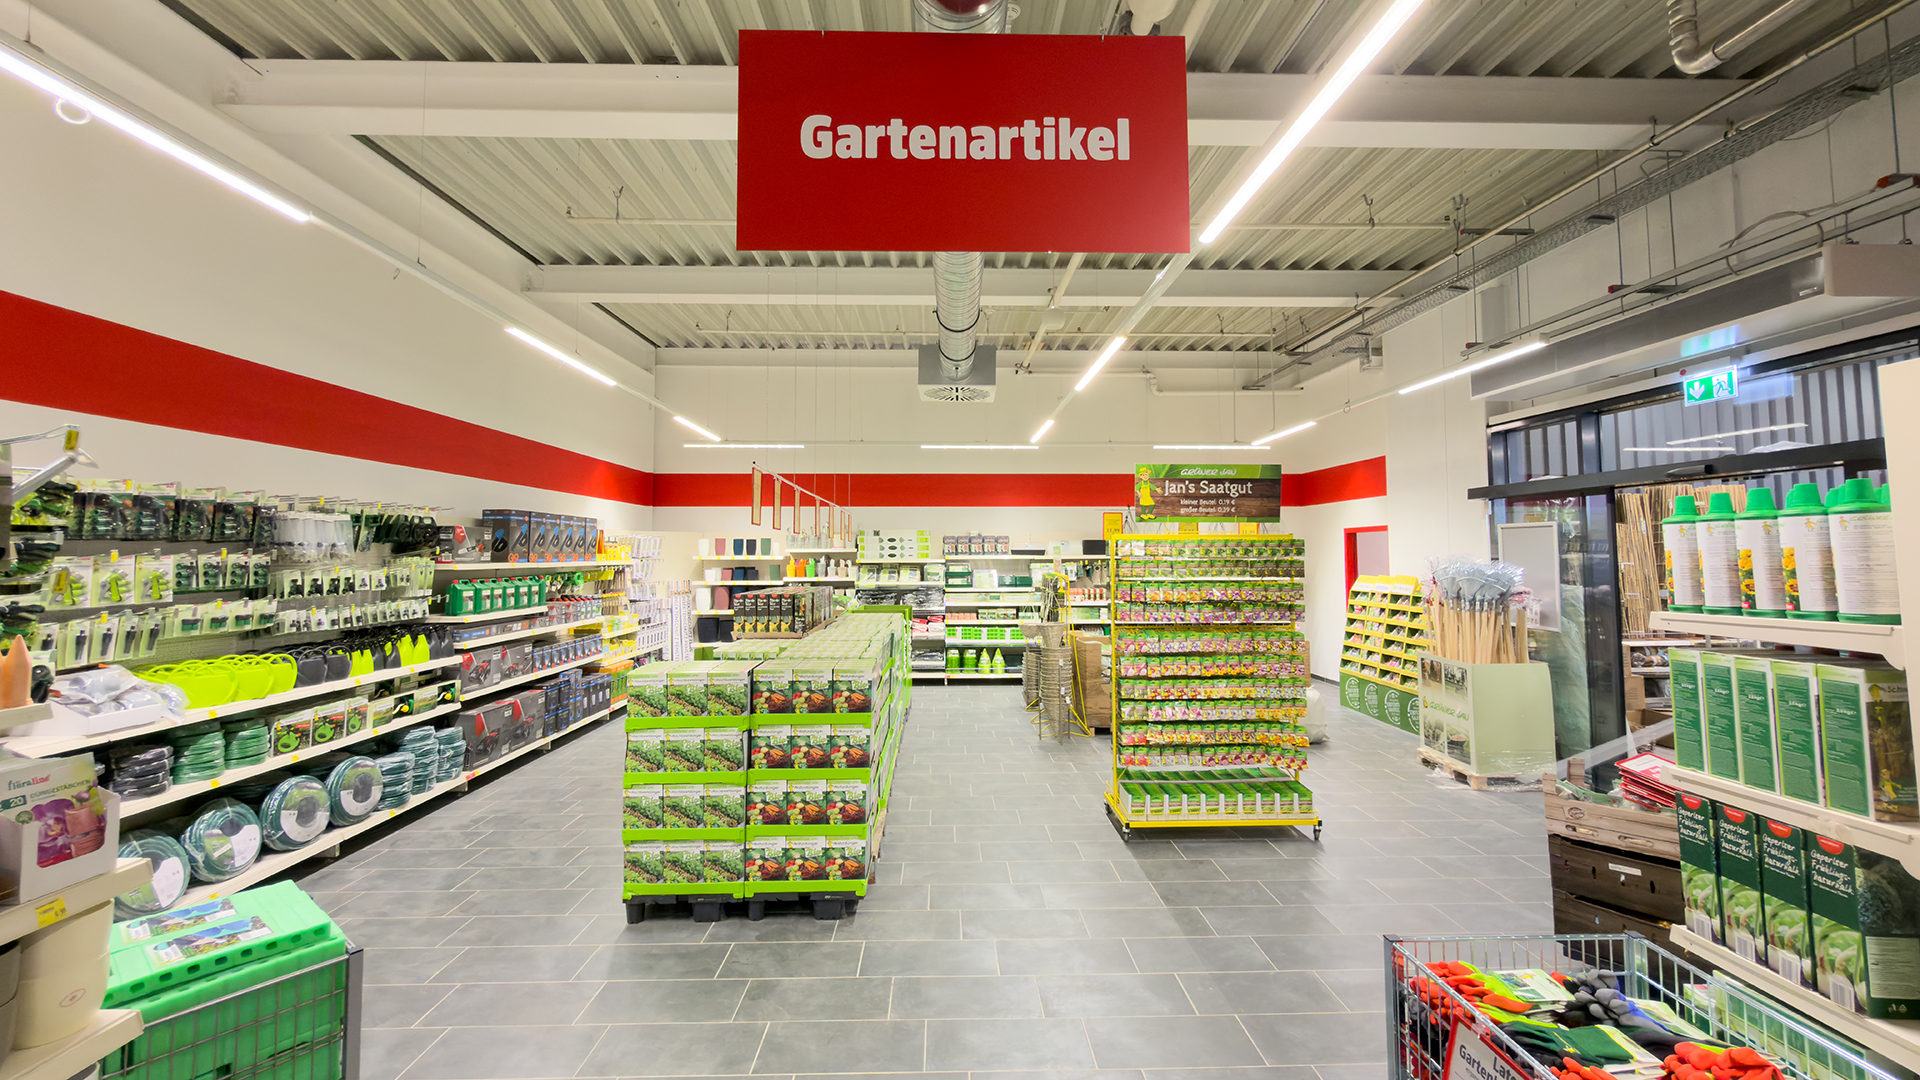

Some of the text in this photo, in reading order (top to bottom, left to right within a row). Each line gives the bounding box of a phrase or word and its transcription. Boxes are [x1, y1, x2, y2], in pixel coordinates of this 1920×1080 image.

[799, 114, 1131, 162] Gartenartikel
[1164, 480, 1253, 498] Jan's Saatgut
[772, 681, 790, 690] Bio
[812, 680, 830, 690] Bio
[852, 680, 870, 690] Bio
[771, 736, 789, 745] Bio
[811, 735, 829, 744] Bio
[851, 735, 869, 744] Bio
[766, 792, 785, 801] Bio
[806, 791, 825, 801] Bio
[846, 791, 865, 800] Bio
[9, 796, 24, 807] 20
[765, 848, 784, 857] Bio
[806, 847, 824, 857] Bio
[845, 847, 864, 857] Bio
